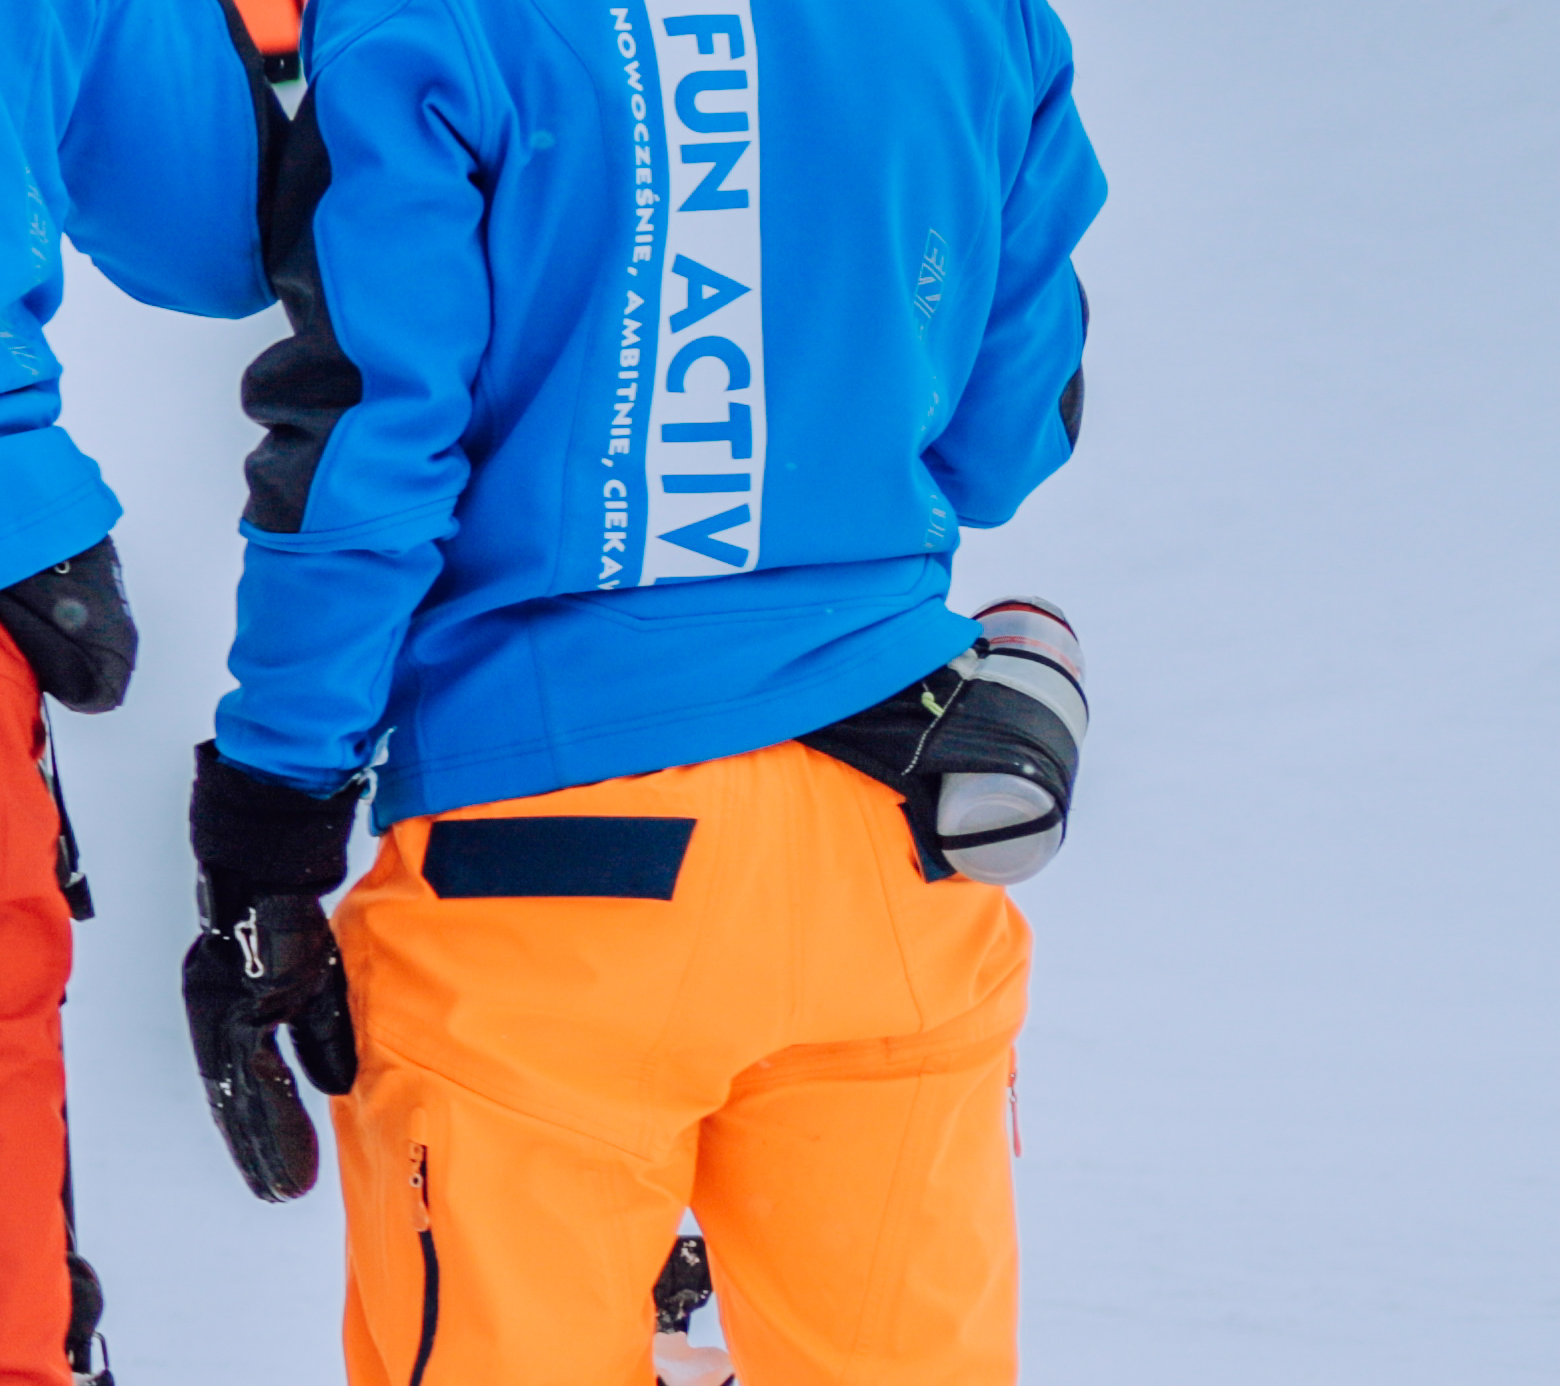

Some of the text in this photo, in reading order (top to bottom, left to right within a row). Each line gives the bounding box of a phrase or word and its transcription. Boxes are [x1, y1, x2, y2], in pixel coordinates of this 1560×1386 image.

[609, 7, 661, 278] NOWOCZEŚNIE,
[601, 290, 646, 469] AMBITNIE,
[657, 14, 753, 575] FUN ACTIV
